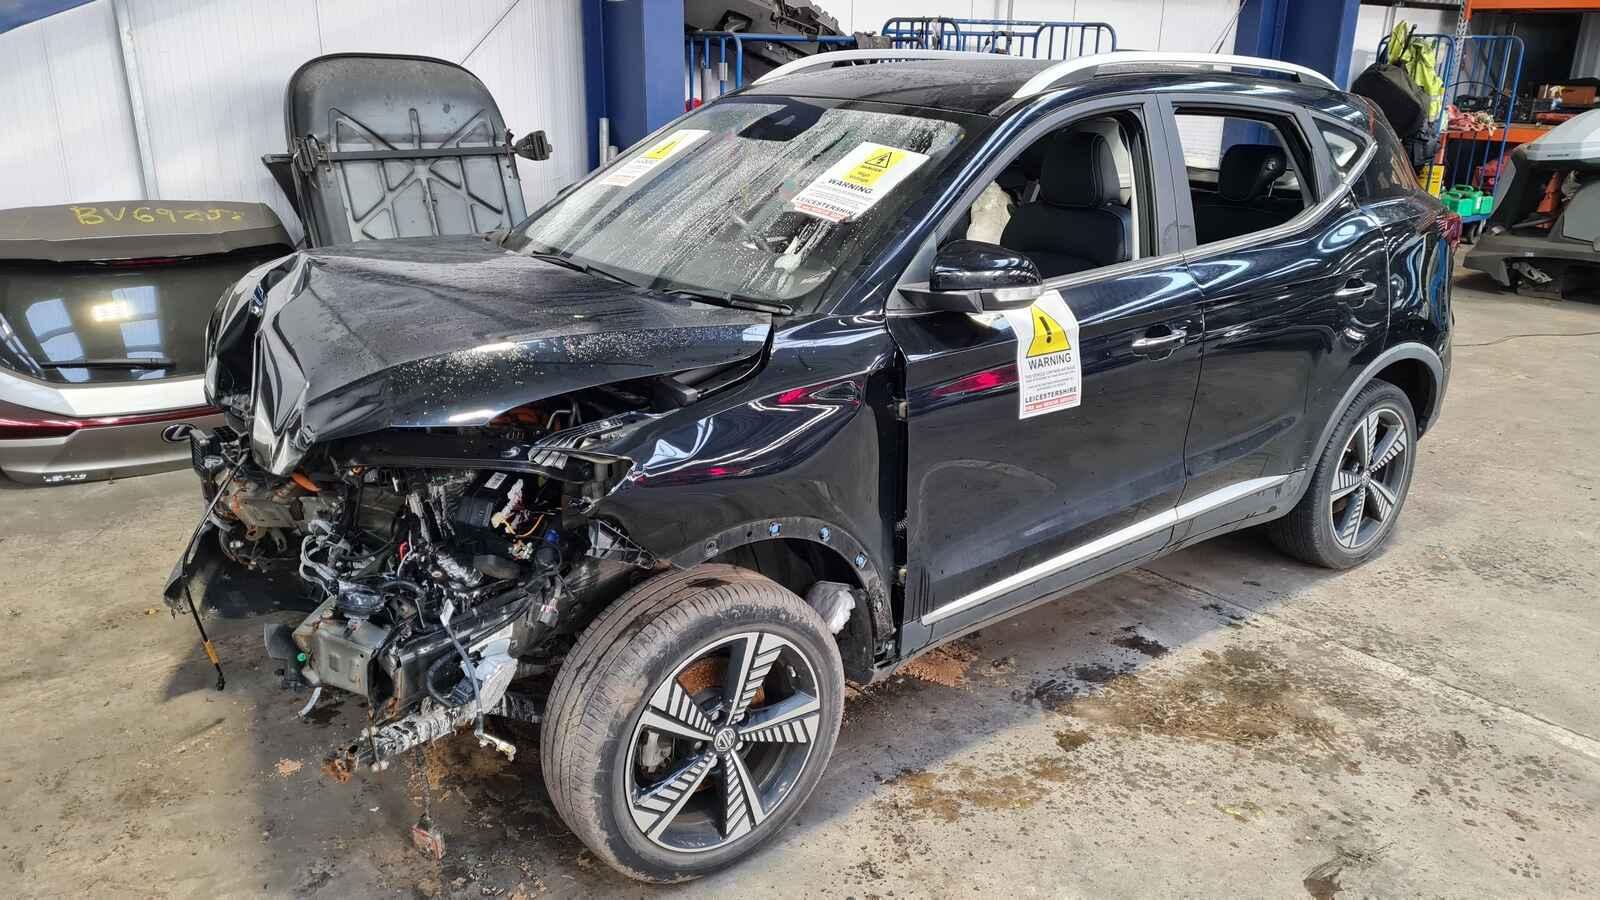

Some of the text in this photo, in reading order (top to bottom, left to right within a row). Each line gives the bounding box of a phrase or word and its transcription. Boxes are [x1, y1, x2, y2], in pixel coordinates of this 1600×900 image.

[828, 178, 873, 194] WARNING
[1028, 353, 1072, 370] WARNING
[1025, 386, 1077, 403] LEICESTERSHIRE
